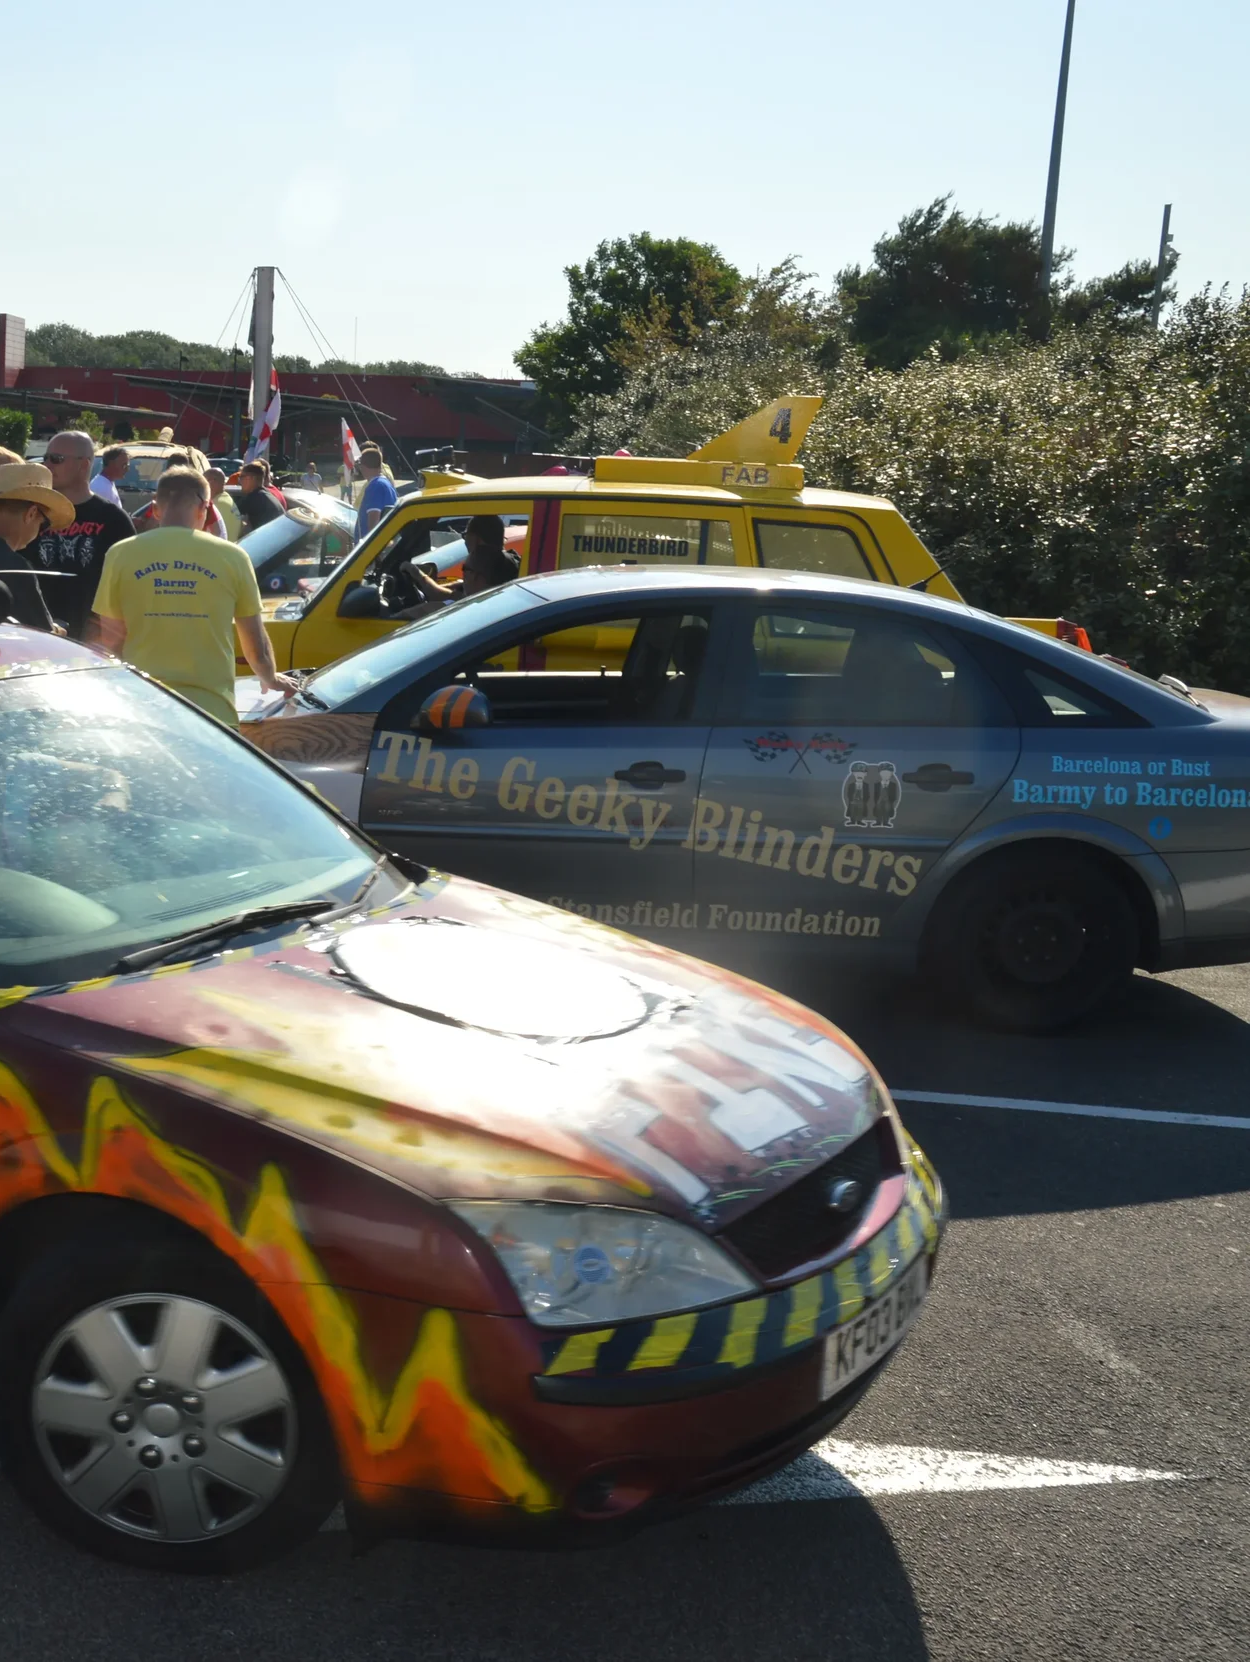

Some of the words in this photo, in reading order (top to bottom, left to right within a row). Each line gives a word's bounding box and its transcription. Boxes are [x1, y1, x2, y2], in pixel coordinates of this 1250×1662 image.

[769, 408, 792, 443] 4
[722, 466, 769, 484] FAB
[573, 535, 690, 556] THUNDERBIRD
[134, 562, 170, 580] Rally
[173, 560, 218, 580] Driver
[154, 578, 198, 589] Barmy
[1051, 756, 1142, 775] Barcelona
[1148, 760, 1167, 775] or
[1171, 759, 1211, 777] Bust
[1012, 779, 1097, 810] Barmy
[1104, 782, 1128, 806] to
[1135, 782, 1250, 808] Barcelon
[376, 730, 480, 800] The
[498, 757, 672, 850] Geeky
[681, 798, 923, 897] Blinders
[709, 904, 881, 937] Foundation
